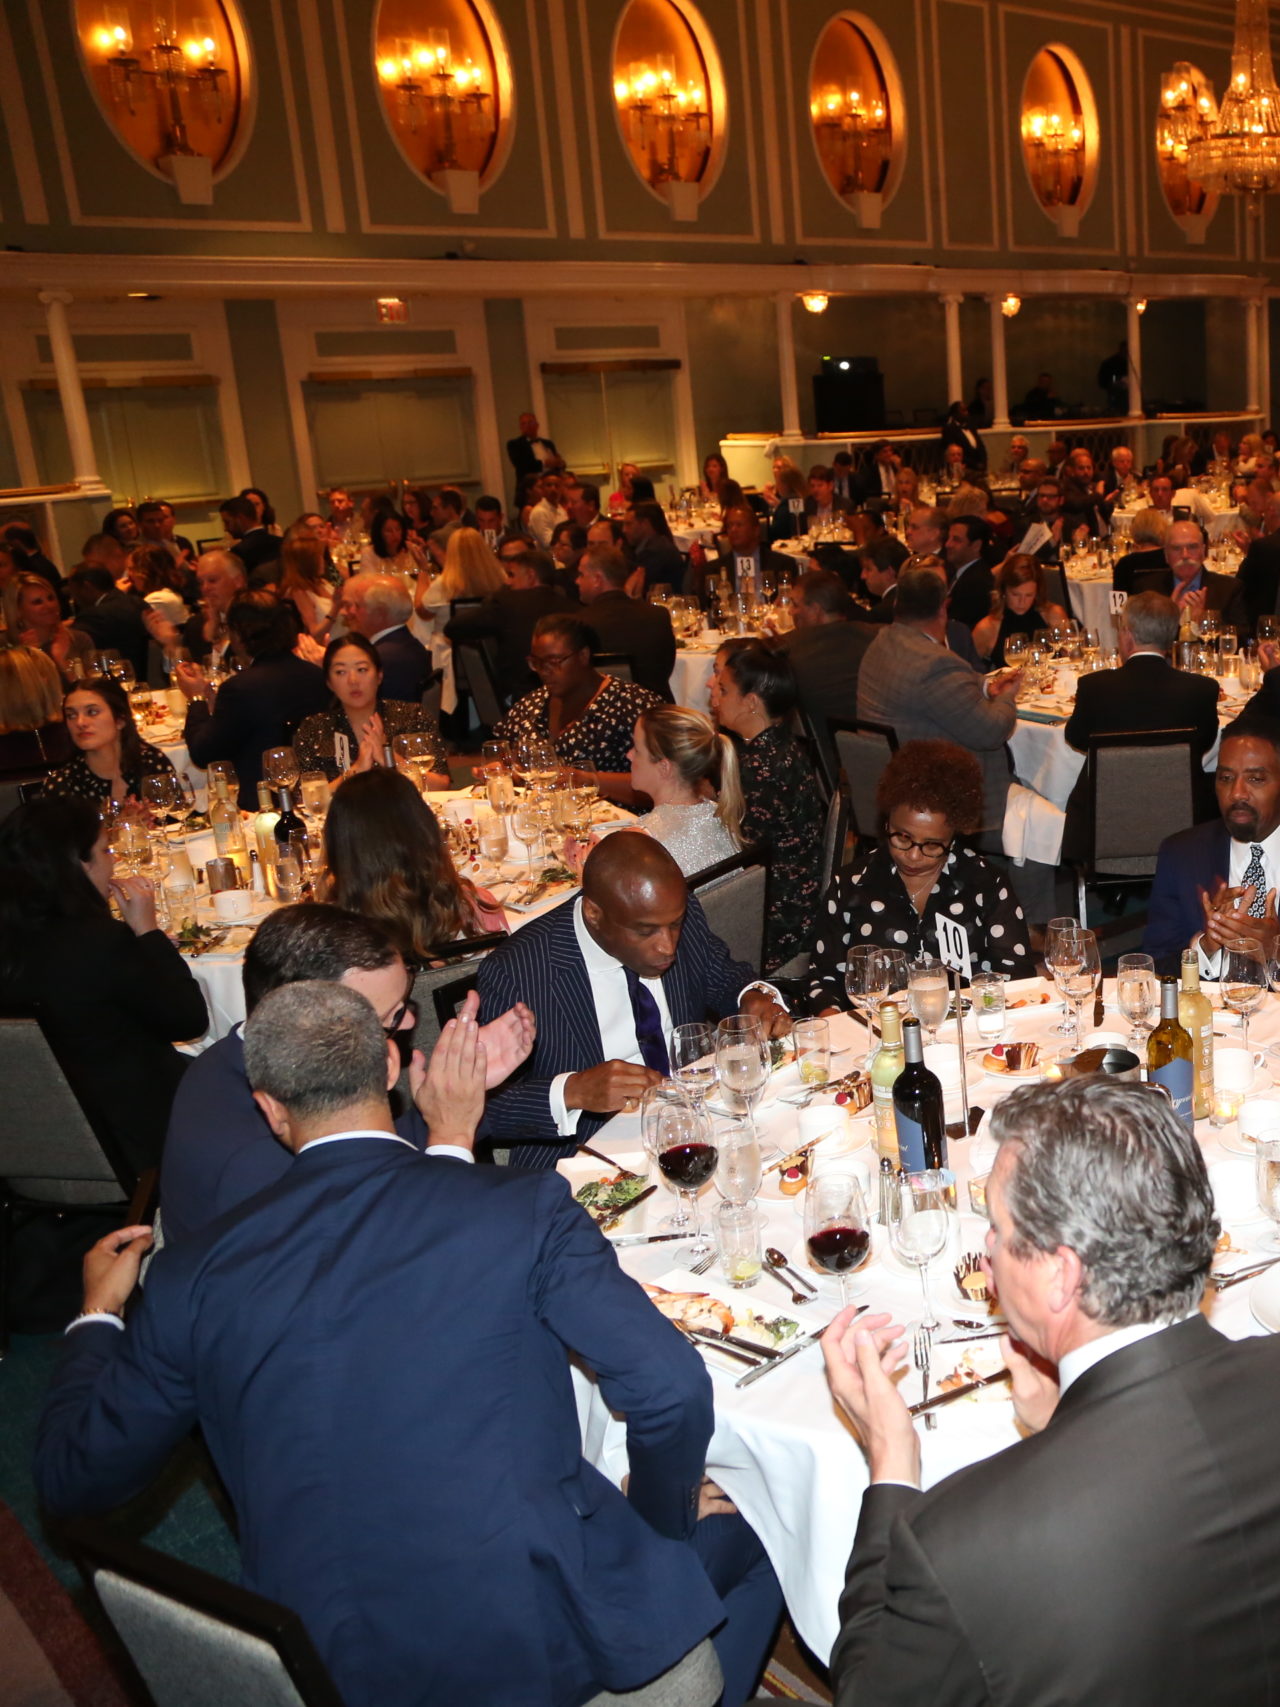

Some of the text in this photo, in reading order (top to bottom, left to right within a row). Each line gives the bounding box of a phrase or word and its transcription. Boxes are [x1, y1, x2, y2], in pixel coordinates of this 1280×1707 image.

[740, 558, 751, 571] 13
[1112, 592, 1125, 608] 12
[941, 921, 963, 960] 10
